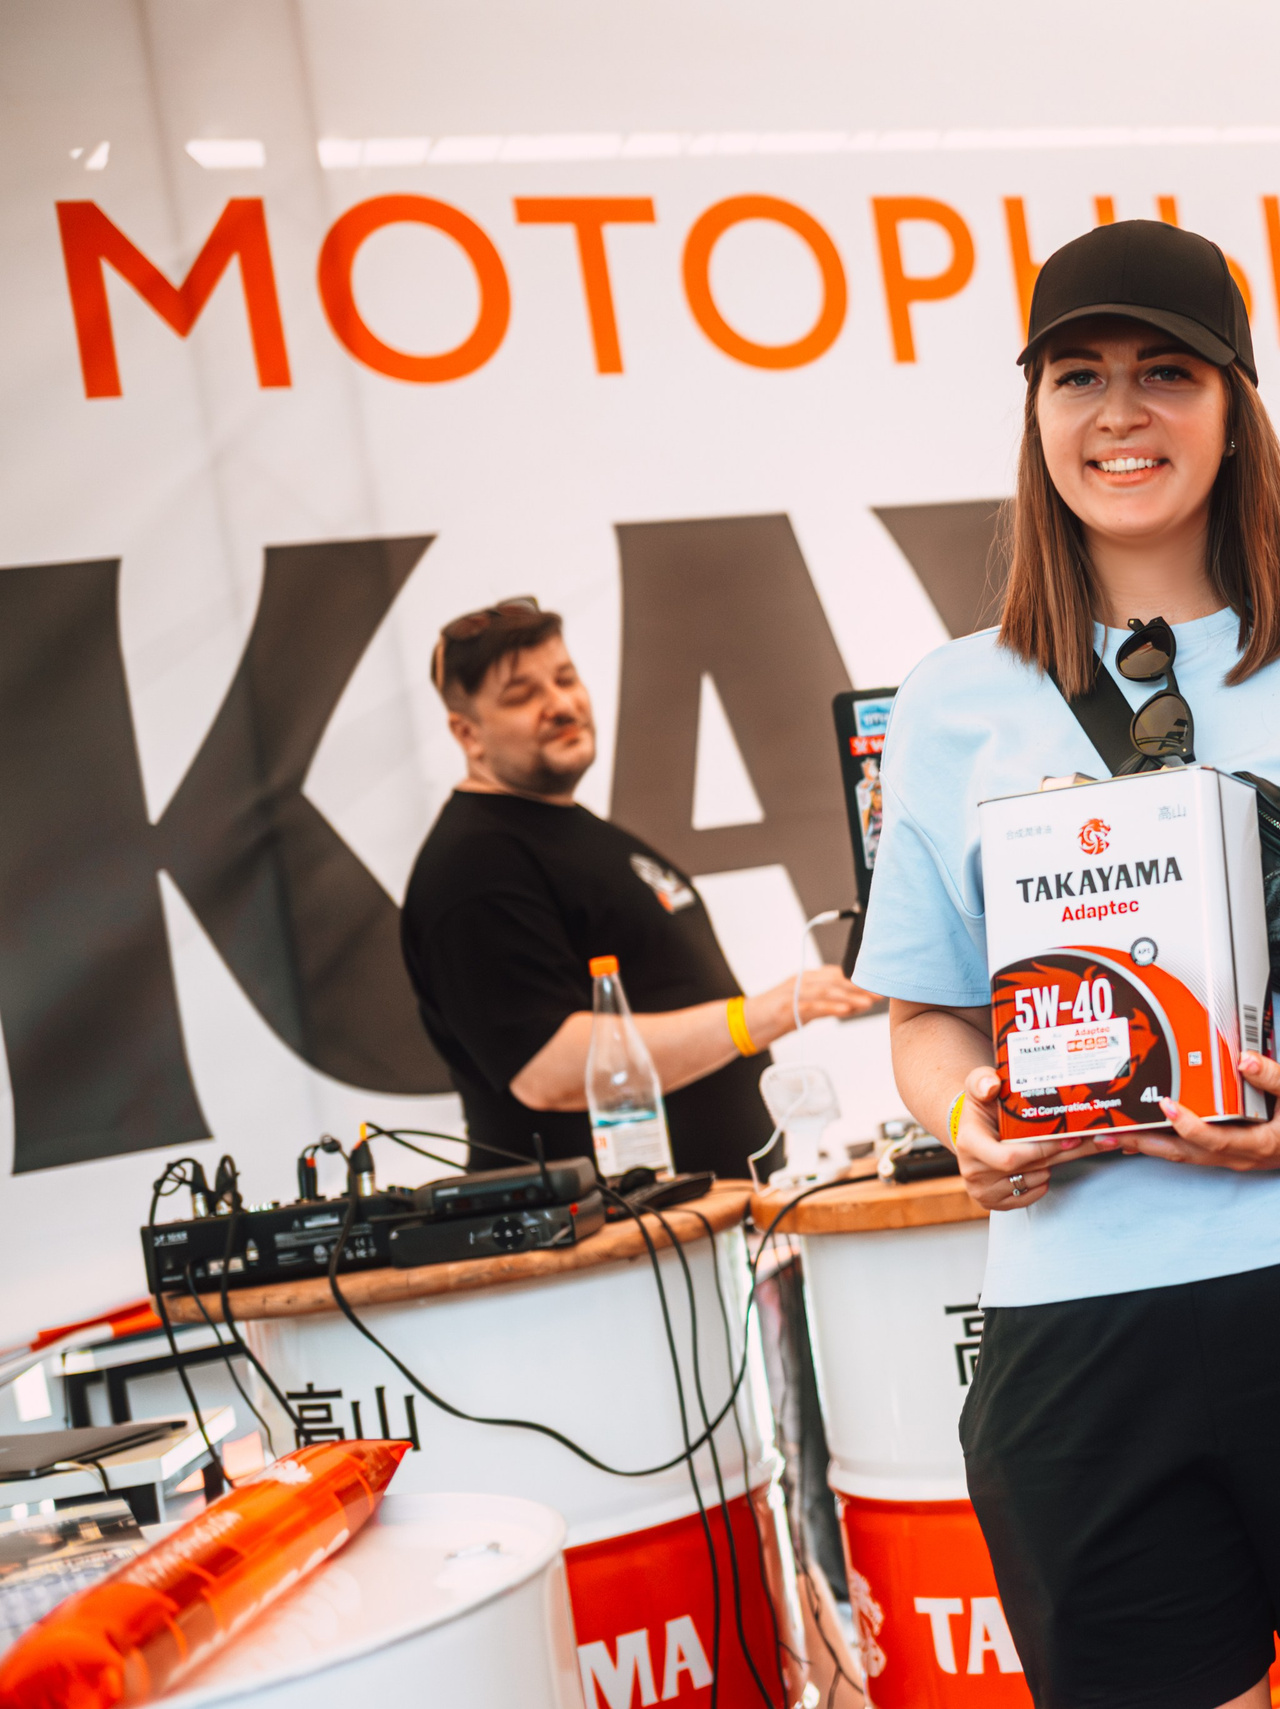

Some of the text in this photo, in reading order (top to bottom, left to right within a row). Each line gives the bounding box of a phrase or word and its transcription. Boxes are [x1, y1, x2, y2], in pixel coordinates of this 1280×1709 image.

[1157, 804, 1187, 822] 高山
[1016, 856, 1183, 904] TAKAYAMA
[1061, 899, 1140, 923] Adaptec
[1014, 977, 1113, 1032] 5W-40
[1140, 1086, 1164, 1102] 4L
[1021, 1098, 1121, 1118] JCI Corporation, Japan
